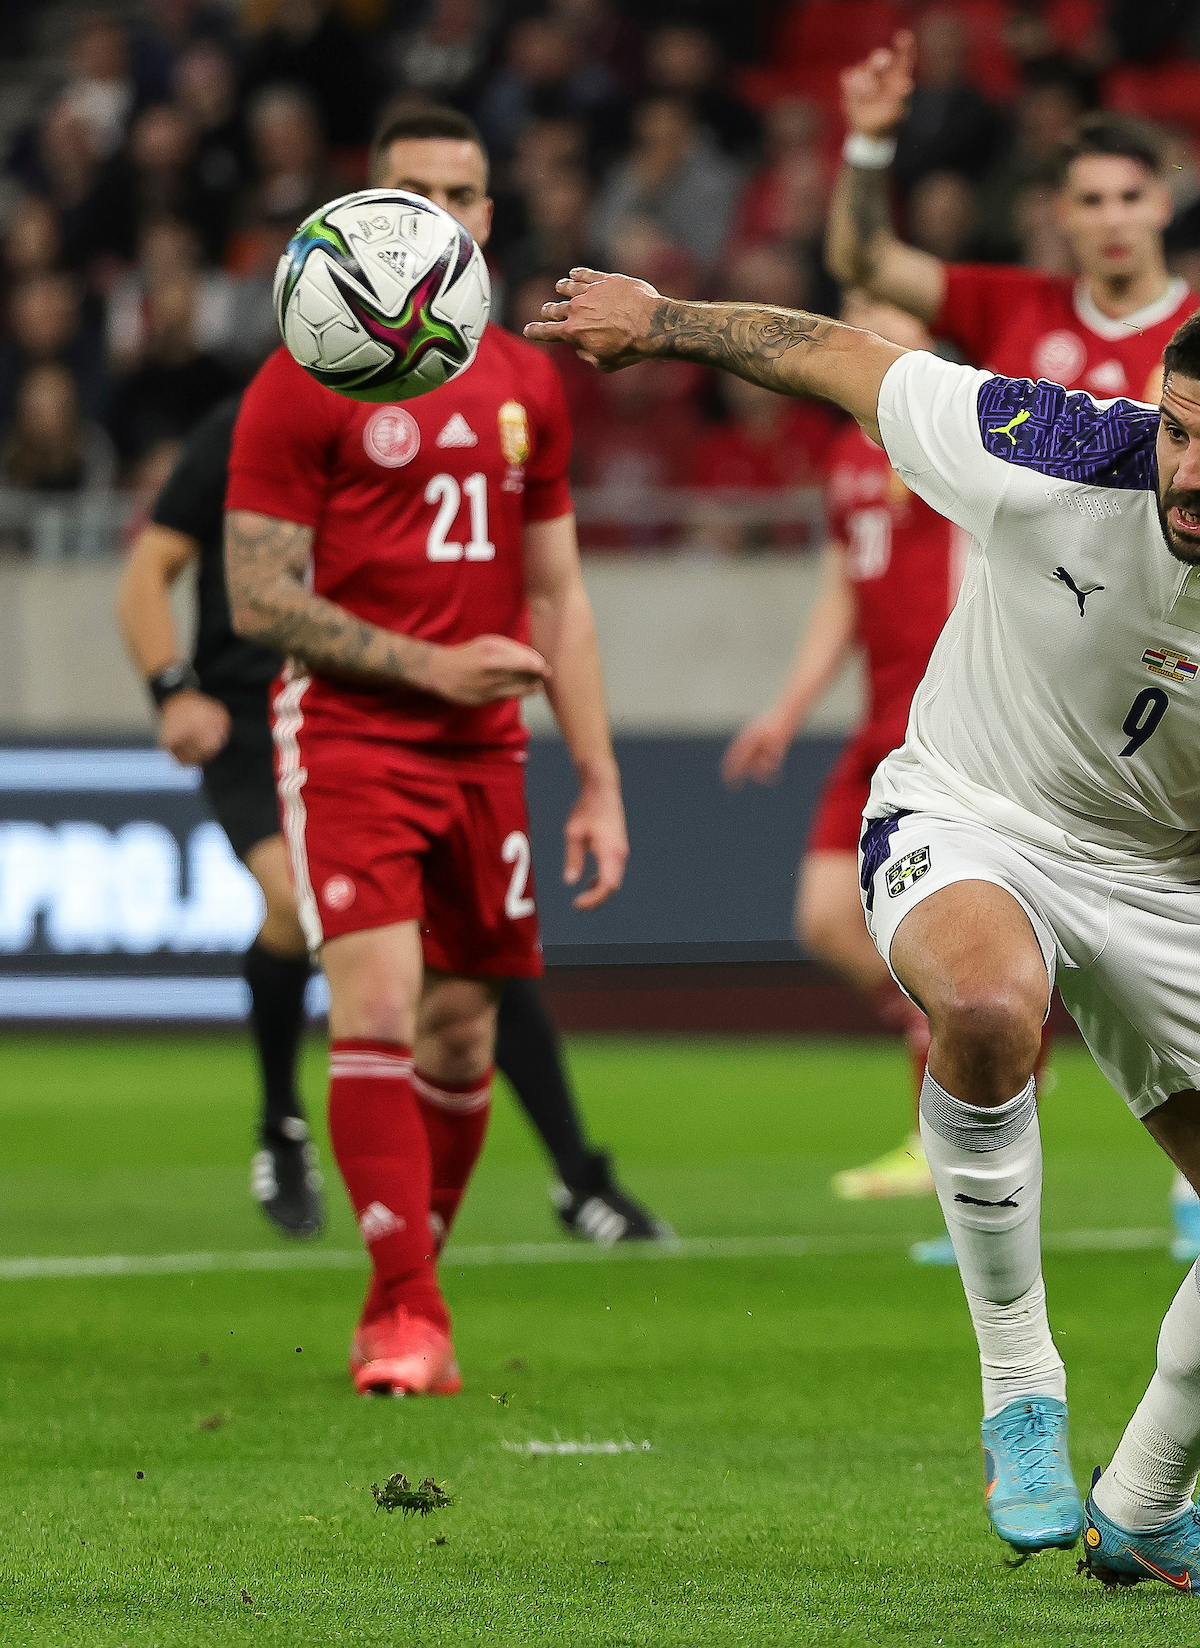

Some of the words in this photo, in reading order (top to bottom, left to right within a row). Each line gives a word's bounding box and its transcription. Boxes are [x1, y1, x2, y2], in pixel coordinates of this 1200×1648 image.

[424, 472, 497, 563] 21
[1118, 686, 1170, 757] 9
[500, 829, 537, 920] 2
